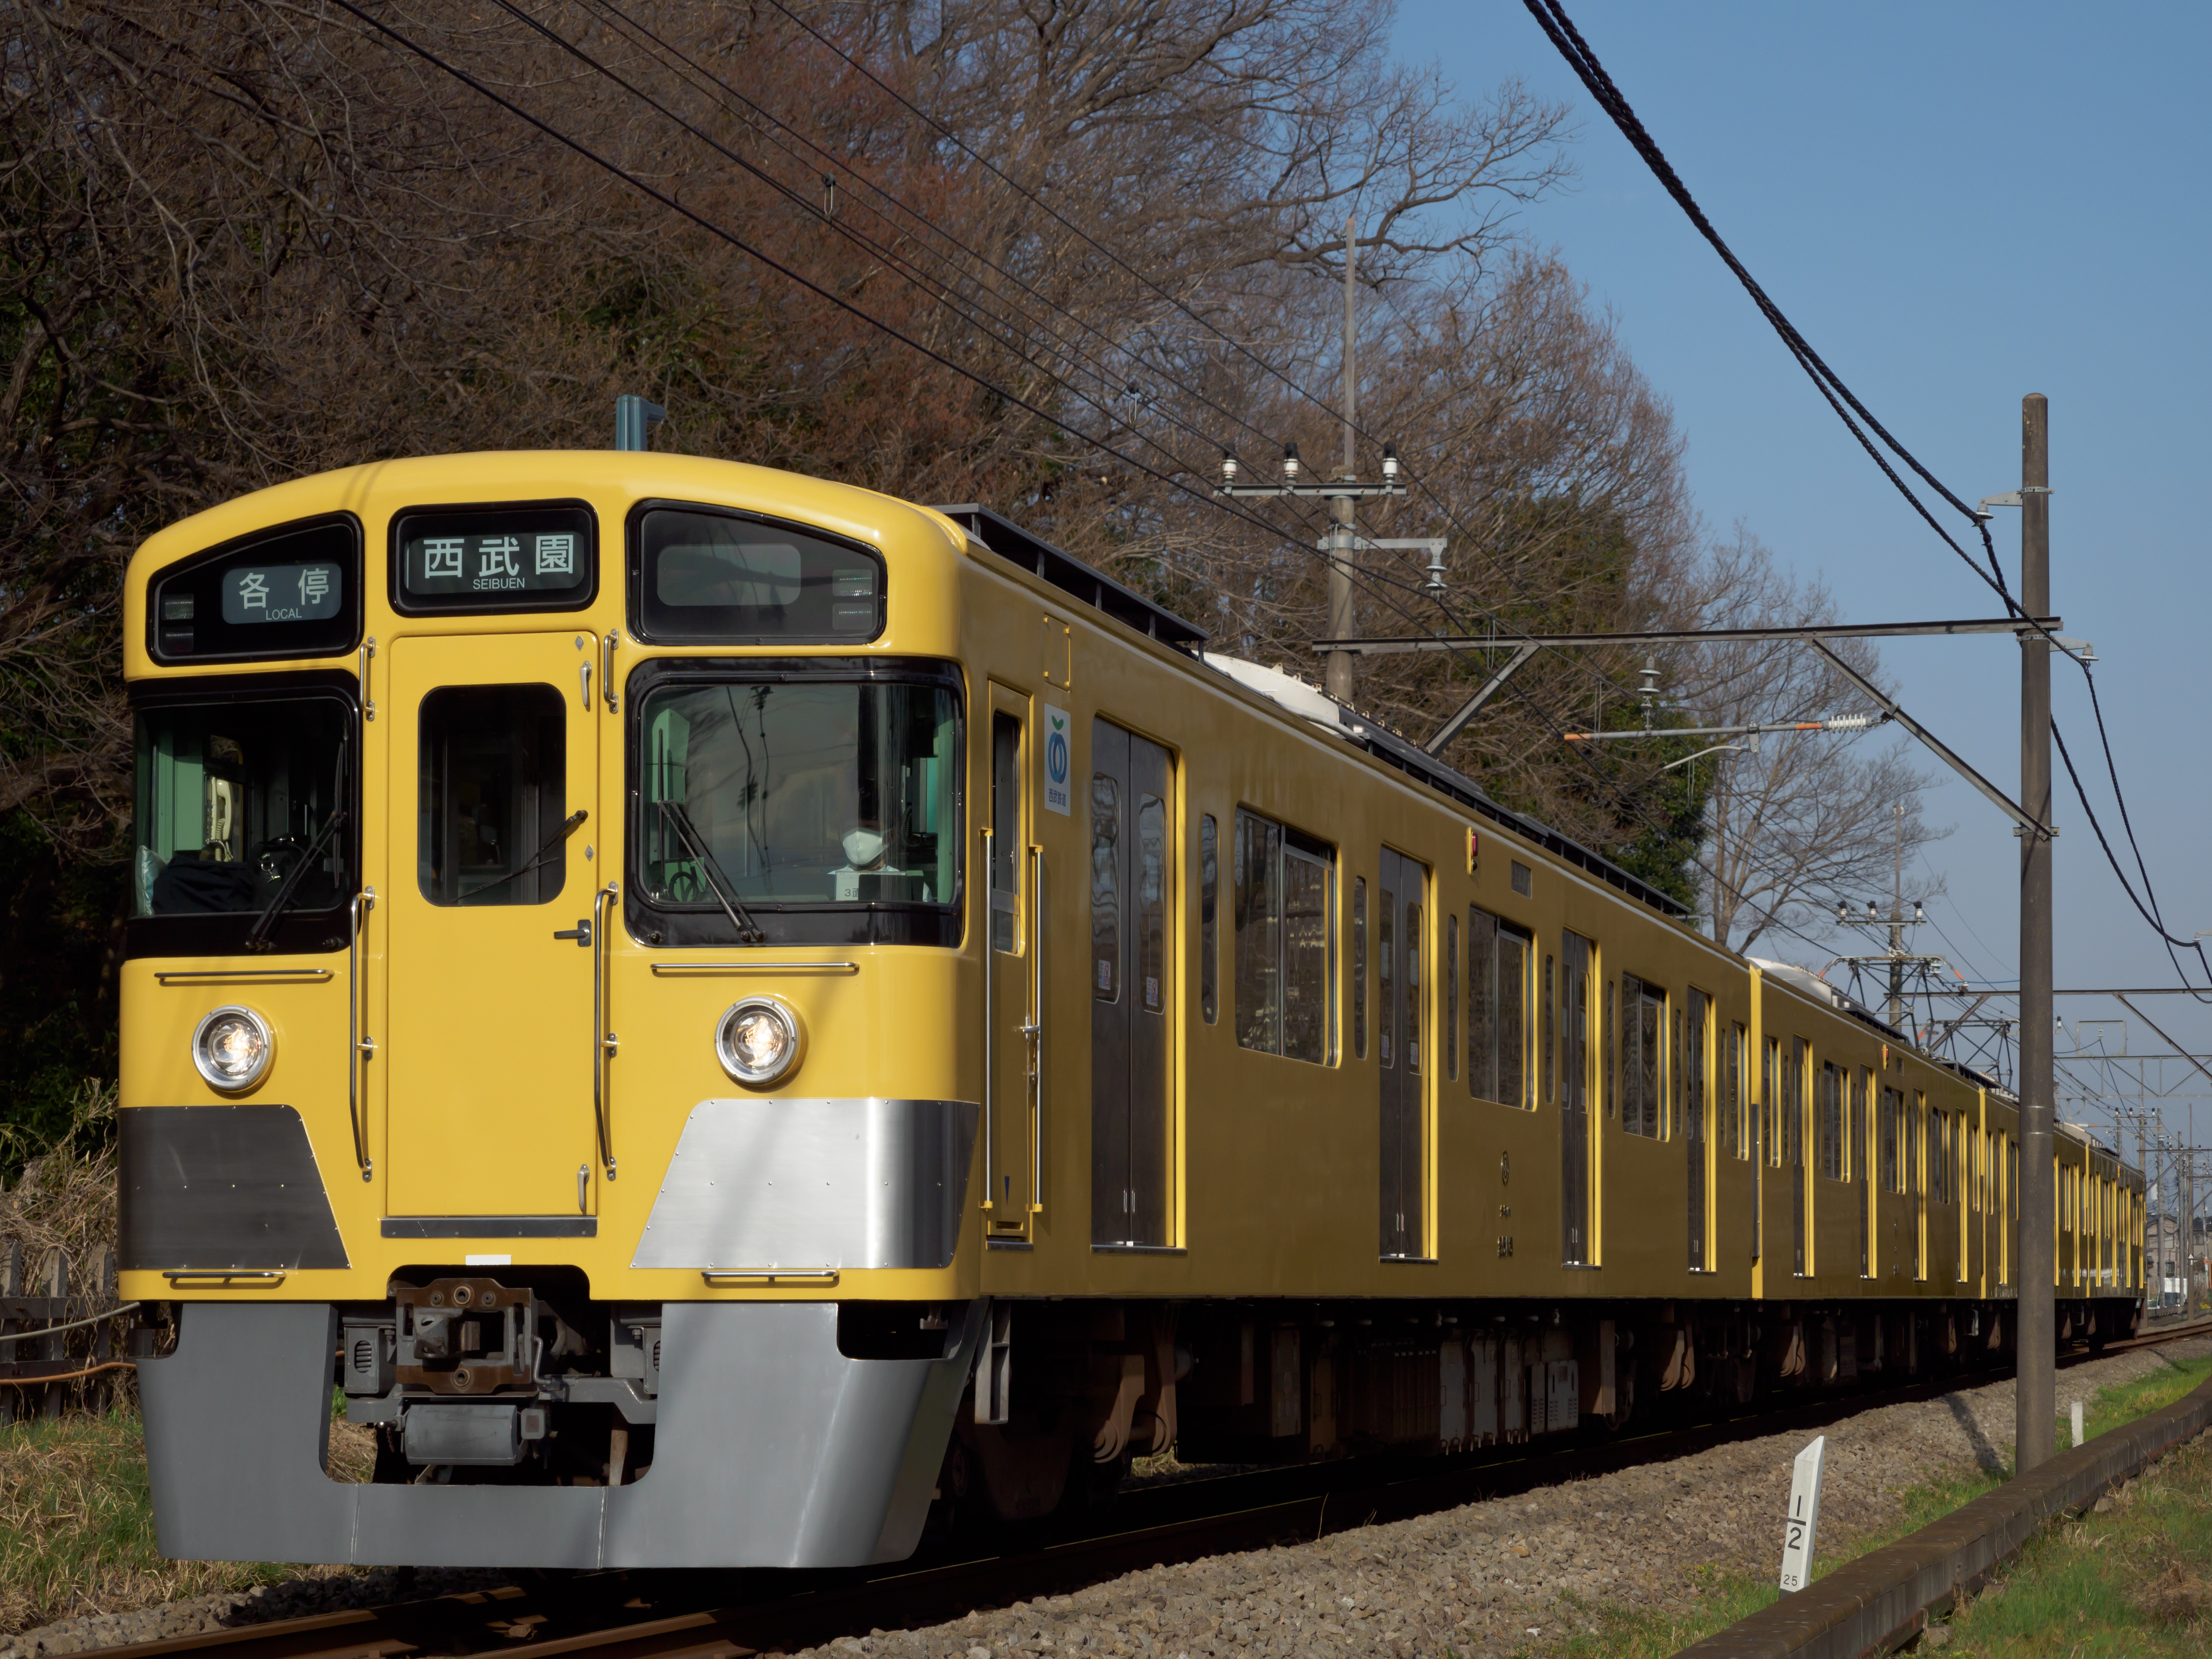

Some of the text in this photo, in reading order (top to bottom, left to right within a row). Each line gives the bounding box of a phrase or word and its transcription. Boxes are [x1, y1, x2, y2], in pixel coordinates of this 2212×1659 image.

[424, 535, 574, 578] 西武園
[239, 568, 329, 609] 各停
[472, 578, 525, 590] SEIBUEN
[266, 608, 302, 620] LOCAL
[1788, 1526, 1802, 1550] 2
[1783, 1574, 1798, 1586] 25
